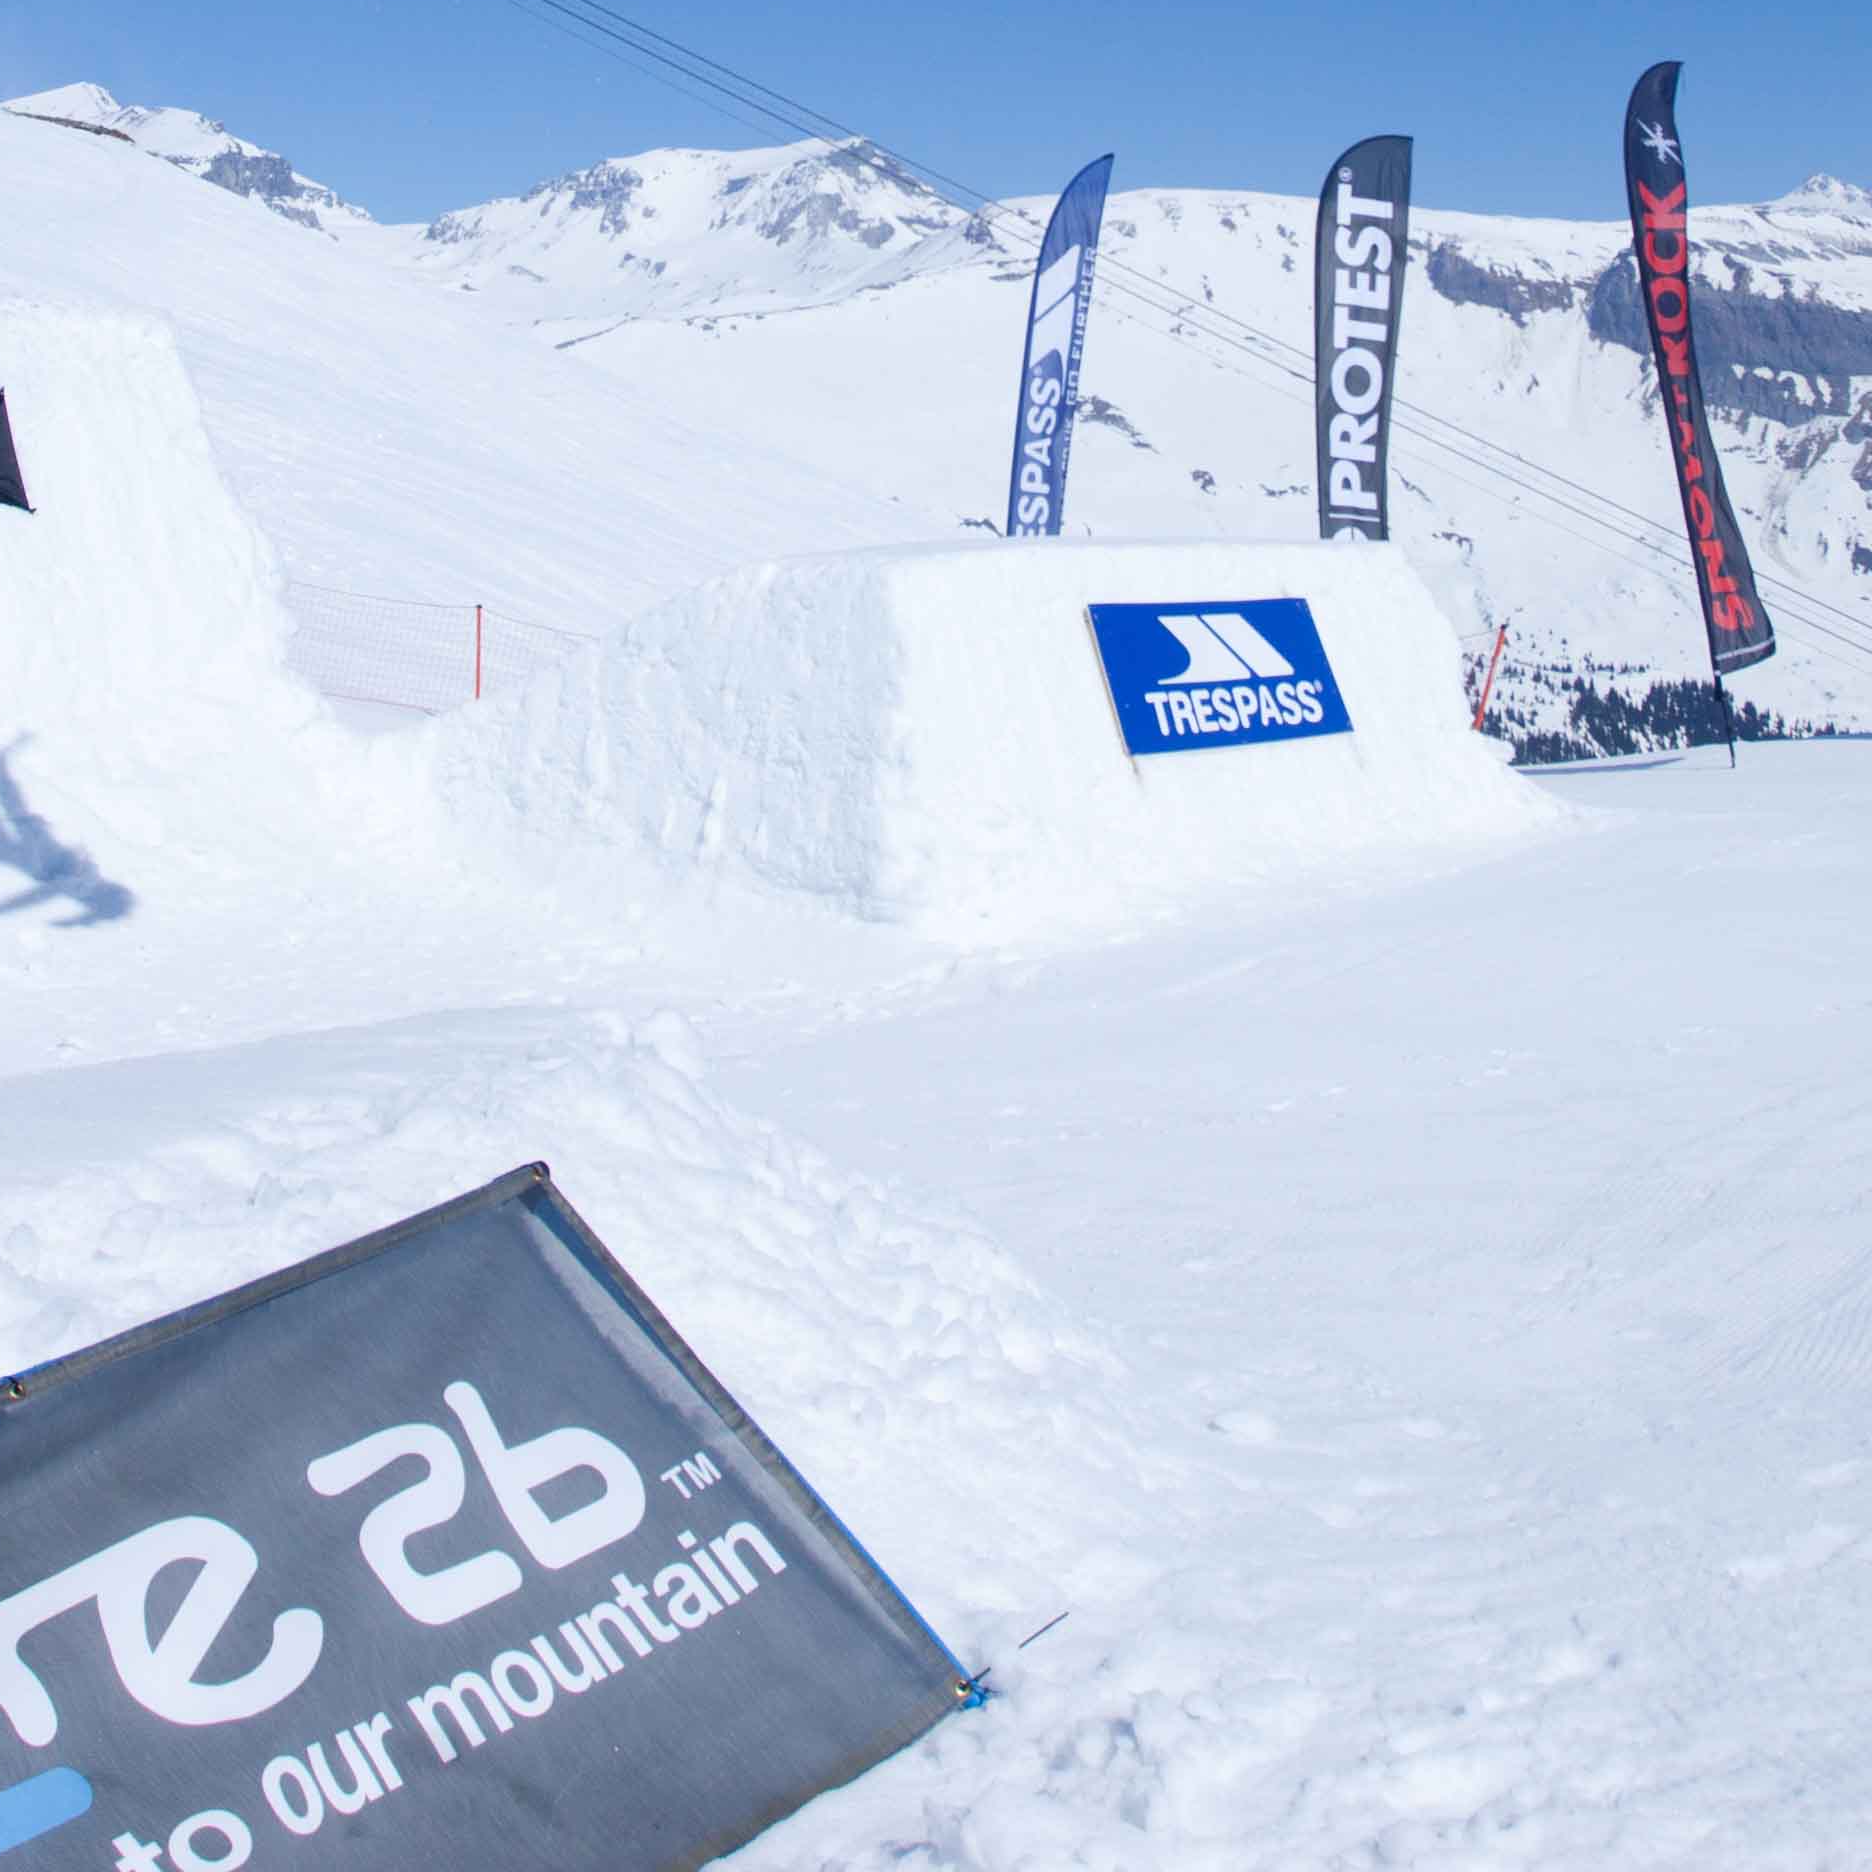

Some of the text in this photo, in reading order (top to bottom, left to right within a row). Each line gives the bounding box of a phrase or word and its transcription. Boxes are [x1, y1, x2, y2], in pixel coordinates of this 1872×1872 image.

[306, 1381, 646, 1625] 2b
[111, 1521, 787, 1872] to our mountain
